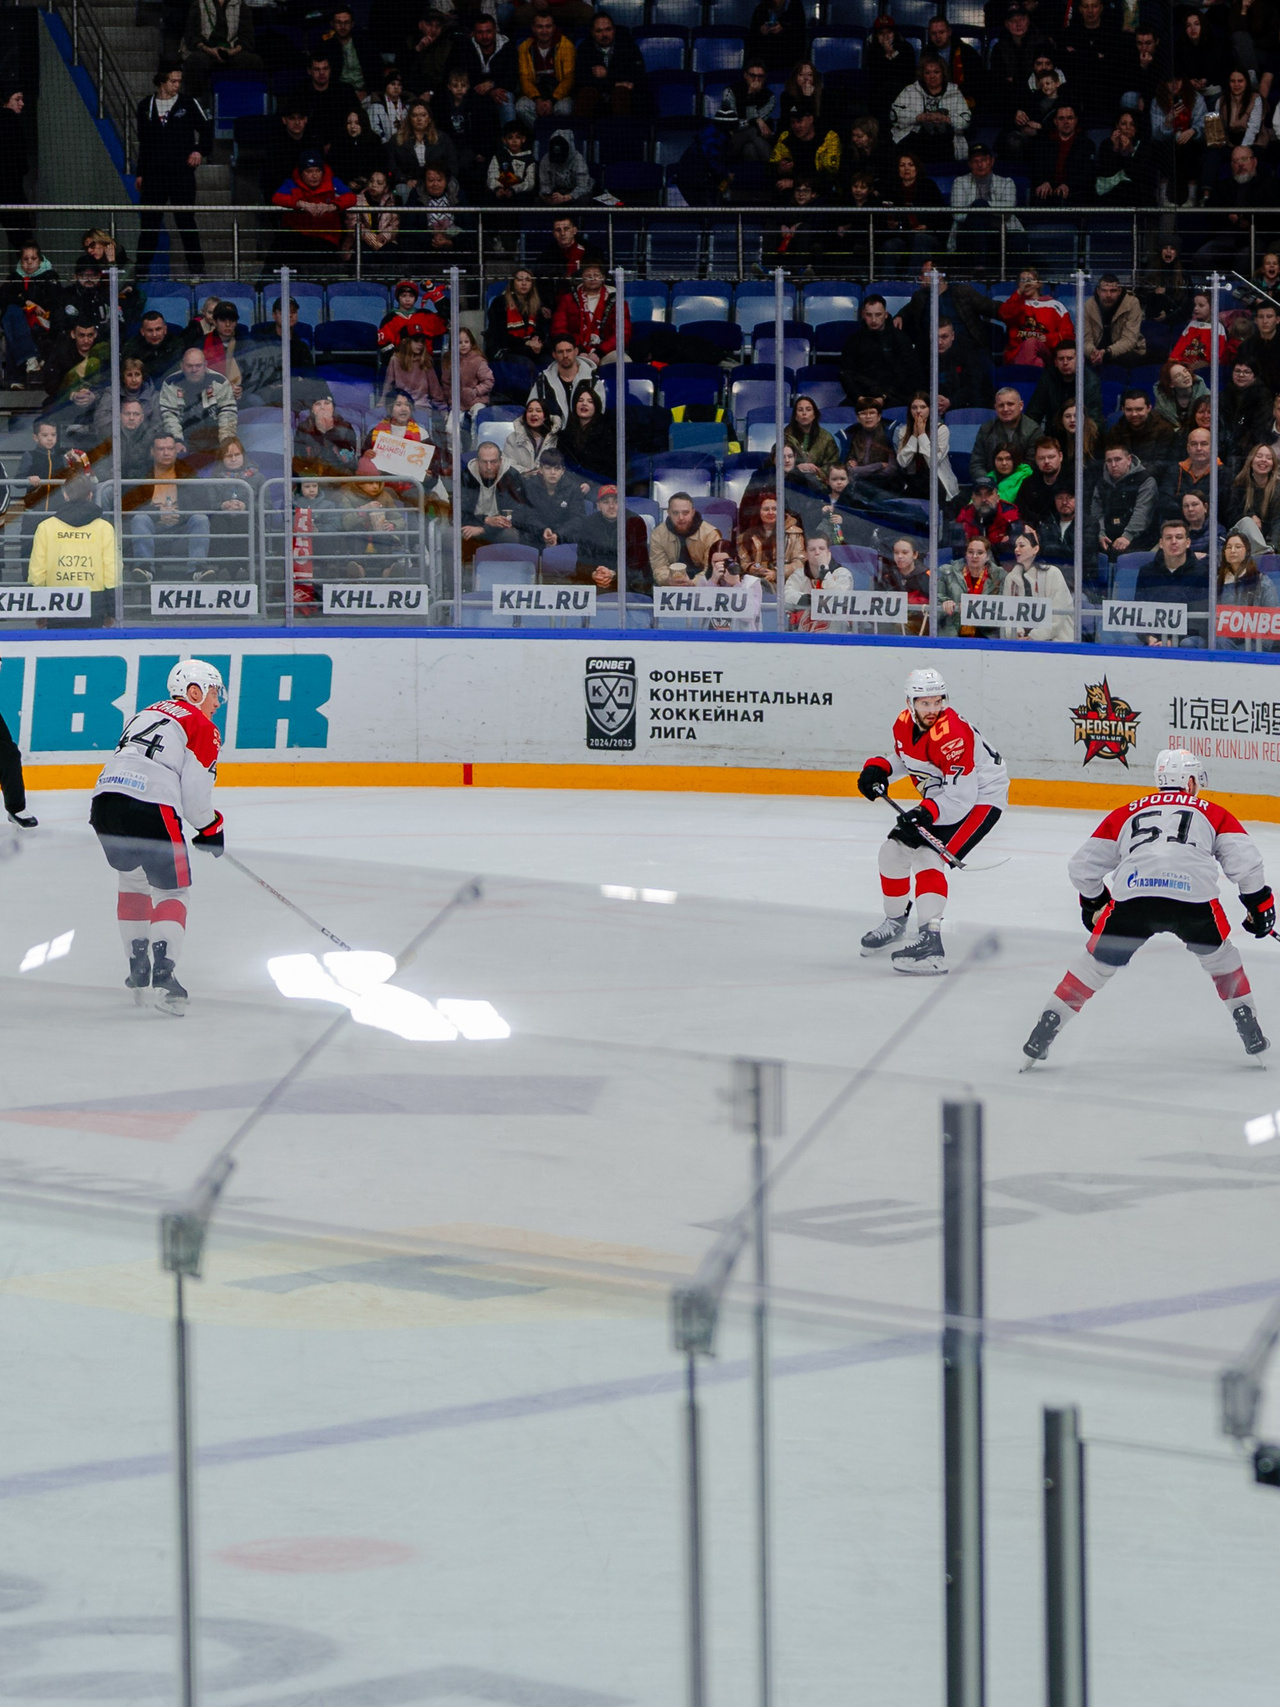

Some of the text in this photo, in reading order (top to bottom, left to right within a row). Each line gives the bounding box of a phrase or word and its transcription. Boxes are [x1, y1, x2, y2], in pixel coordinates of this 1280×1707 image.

[57, 531, 92, 540] SAFETY
[57, 556, 93, 568] K3721
[56, 572, 95, 581] SAFETY
[158, 589, 251, 608] KHL.RU
[330, 590, 422, 609] KHL.RU
[499, 590, 590, 610] KHL.RU
[659, 592, 748, 612] KHL.RU
[816, 594, 901, 617] KHL.RU
[966, 600, 1047, 623] KHL.RU
[1107, 606, 1182, 630] KHL.RU
[589, 659, 632, 670] FONBET
[649, 670, 724, 684] ФОНБЕТ
[592, 685, 629, 698] К Л
[649, 688, 833, 706] КОНТИНЕНТАЛЬНАЯ
[649, 706, 764, 723] ХОККЕЙНАЯ
[649, 726, 698, 740] ЛИГА
[1070, 717, 1141, 748] REDSTAR
[589, 738, 633, 748] 2024/2025
[1216, 739, 1259, 760] KUNLUN
[1158, 774, 1168, 785] 51
[1129, 794, 1209, 811] SPOONER
[1129, 810, 1197, 854] 51
[1136, 879, 1191, 892] ГАЗПРОМНЕФТЬ
[321, 927, 352, 951] CCM
